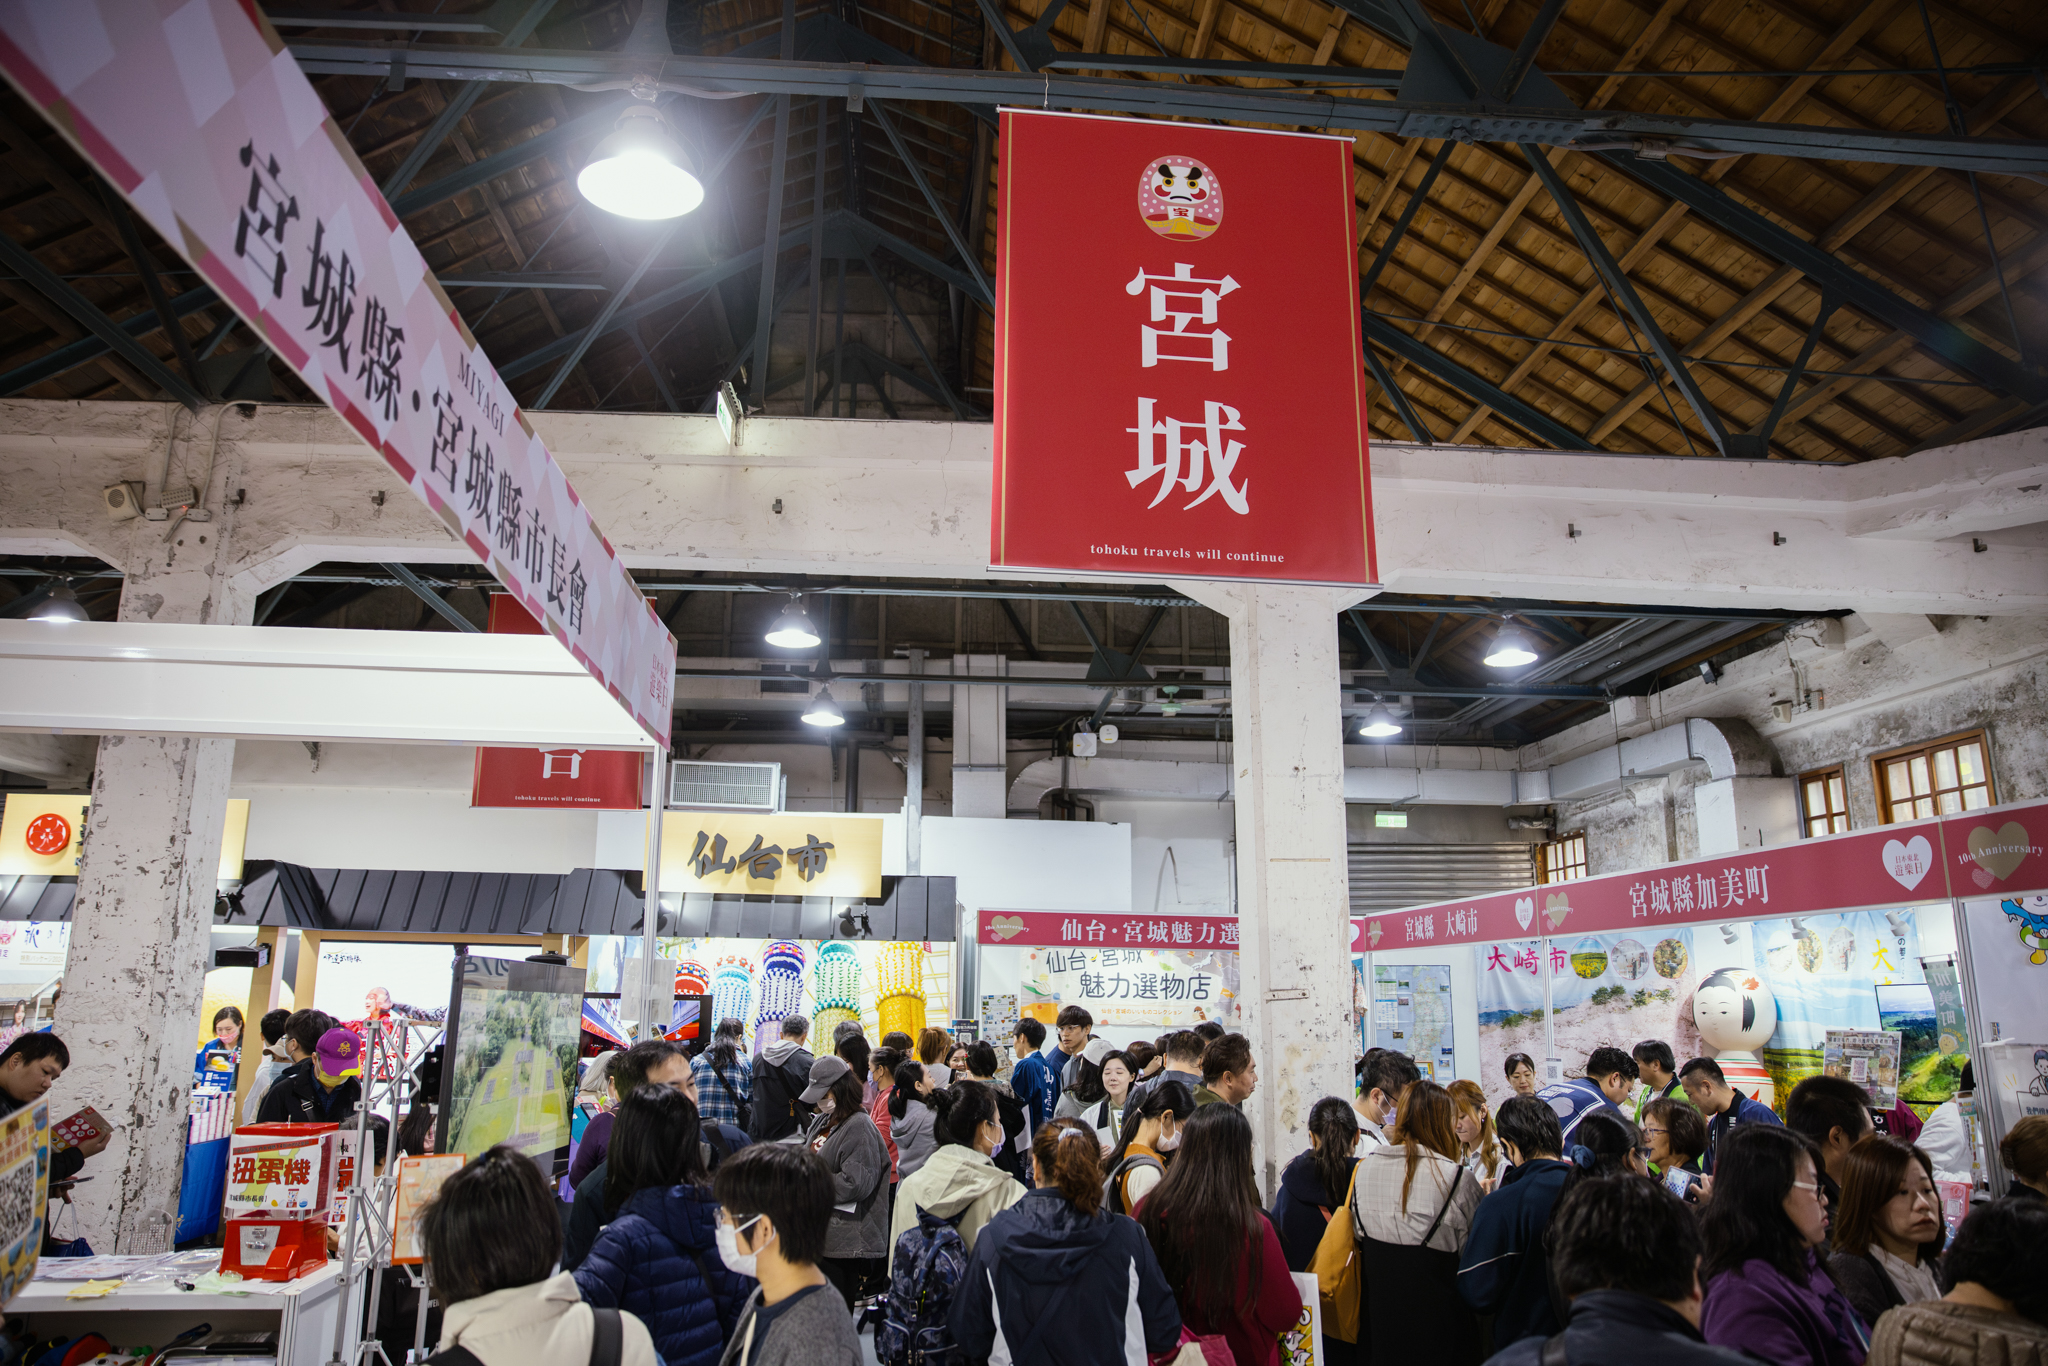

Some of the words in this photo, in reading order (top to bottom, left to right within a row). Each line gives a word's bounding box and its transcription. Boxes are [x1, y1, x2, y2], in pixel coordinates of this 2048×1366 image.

[457, 352, 506, 438] MIYAGI
[1124, 262, 1250, 516] 宮城
[1090, 544, 1138, 556] tohoku
[1143, 546, 1191, 558] travels
[1196, 549, 1221, 560] will
[1226, 551, 1285, 563] continue
[687, 830, 835, 883] 仙台市
[1957, 851, 1977, 865] 10th
[1978, 843, 2044, 857] Anniversary
[1628, 863, 1770, 919] 宮城縣加美町
[1404, 913, 1435, 942] 宮城縣
[1444, 907, 1478, 938] 大崎市
[1486, 945, 1568, 976] 大崎市
[1078, 970, 1212, 1000] 魅力選物店
[232, 1156, 311, 1186] 扭蛋機
